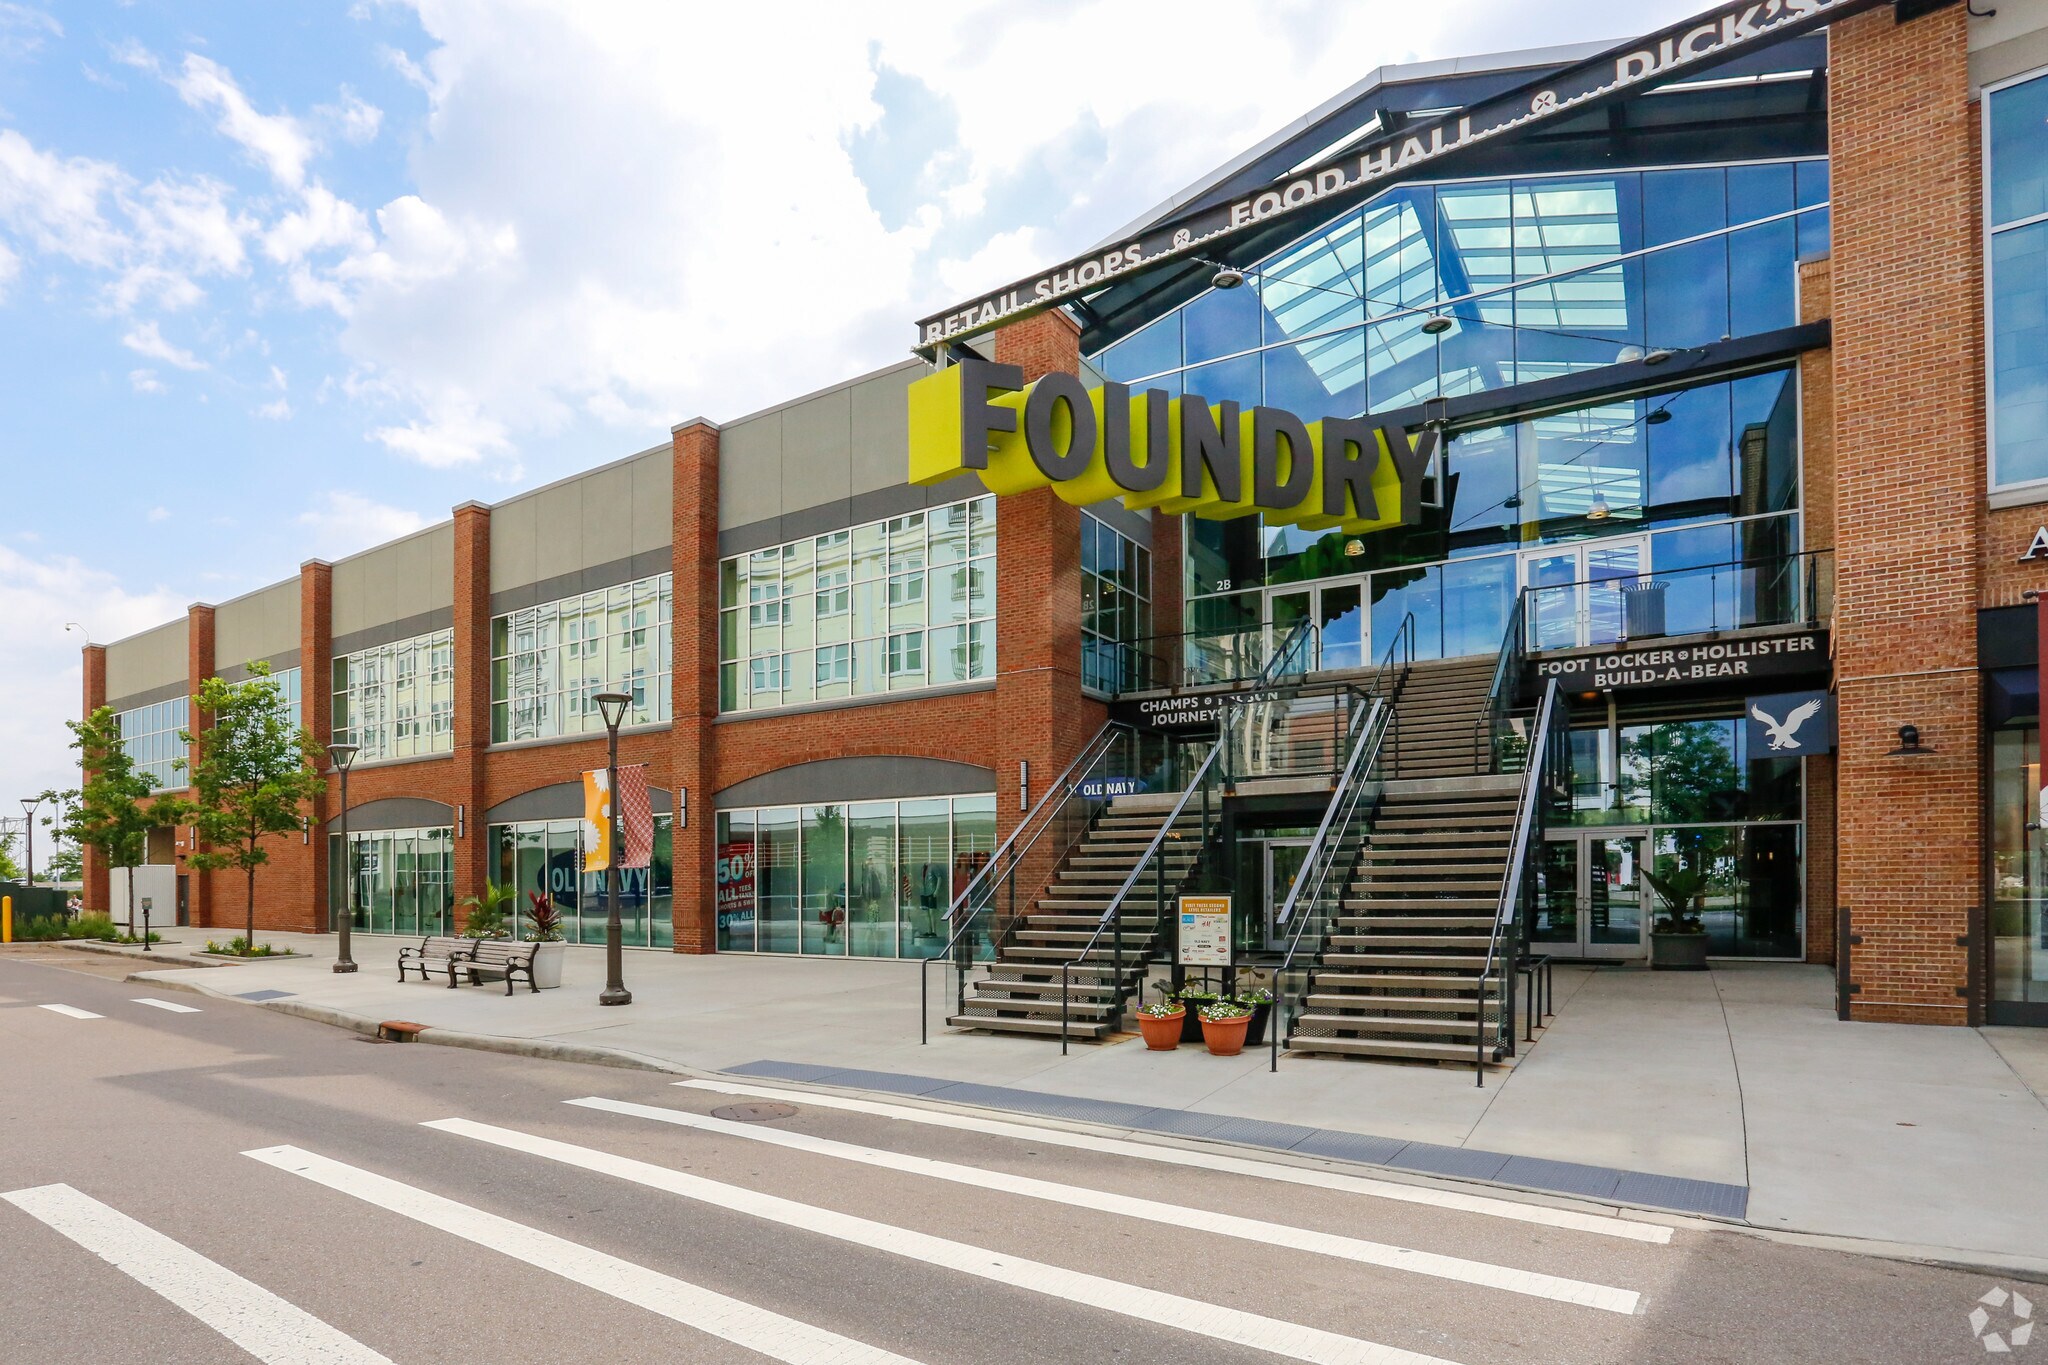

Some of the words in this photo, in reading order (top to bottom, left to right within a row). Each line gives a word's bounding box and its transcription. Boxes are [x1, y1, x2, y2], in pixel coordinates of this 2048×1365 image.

[926, 291, 1023, 341] RETAIL
[1034, 243, 1143, 299] SHOPS
[1230, 167, 1346, 228] FOOD
[1359, 116, 1474, 181] HALL
[960, 358, 1439, 525] FOUNDRY
[1216, 579, 1231, 591] 2B
[1538, 658, 1589, 675] FOOT
[1595, 651, 1675, 670] LOCKER
[1692, 636, 1815, 661] HOLLISTER
[1594, 660, 1749, 687] BUILD-A-BEAR
[1140, 697, 1199, 712] CHAMPS
[1083, 784, 1103, 796] OLD
[551, 867, 583, 892] OL
[594, 867, 648, 892] NVY
